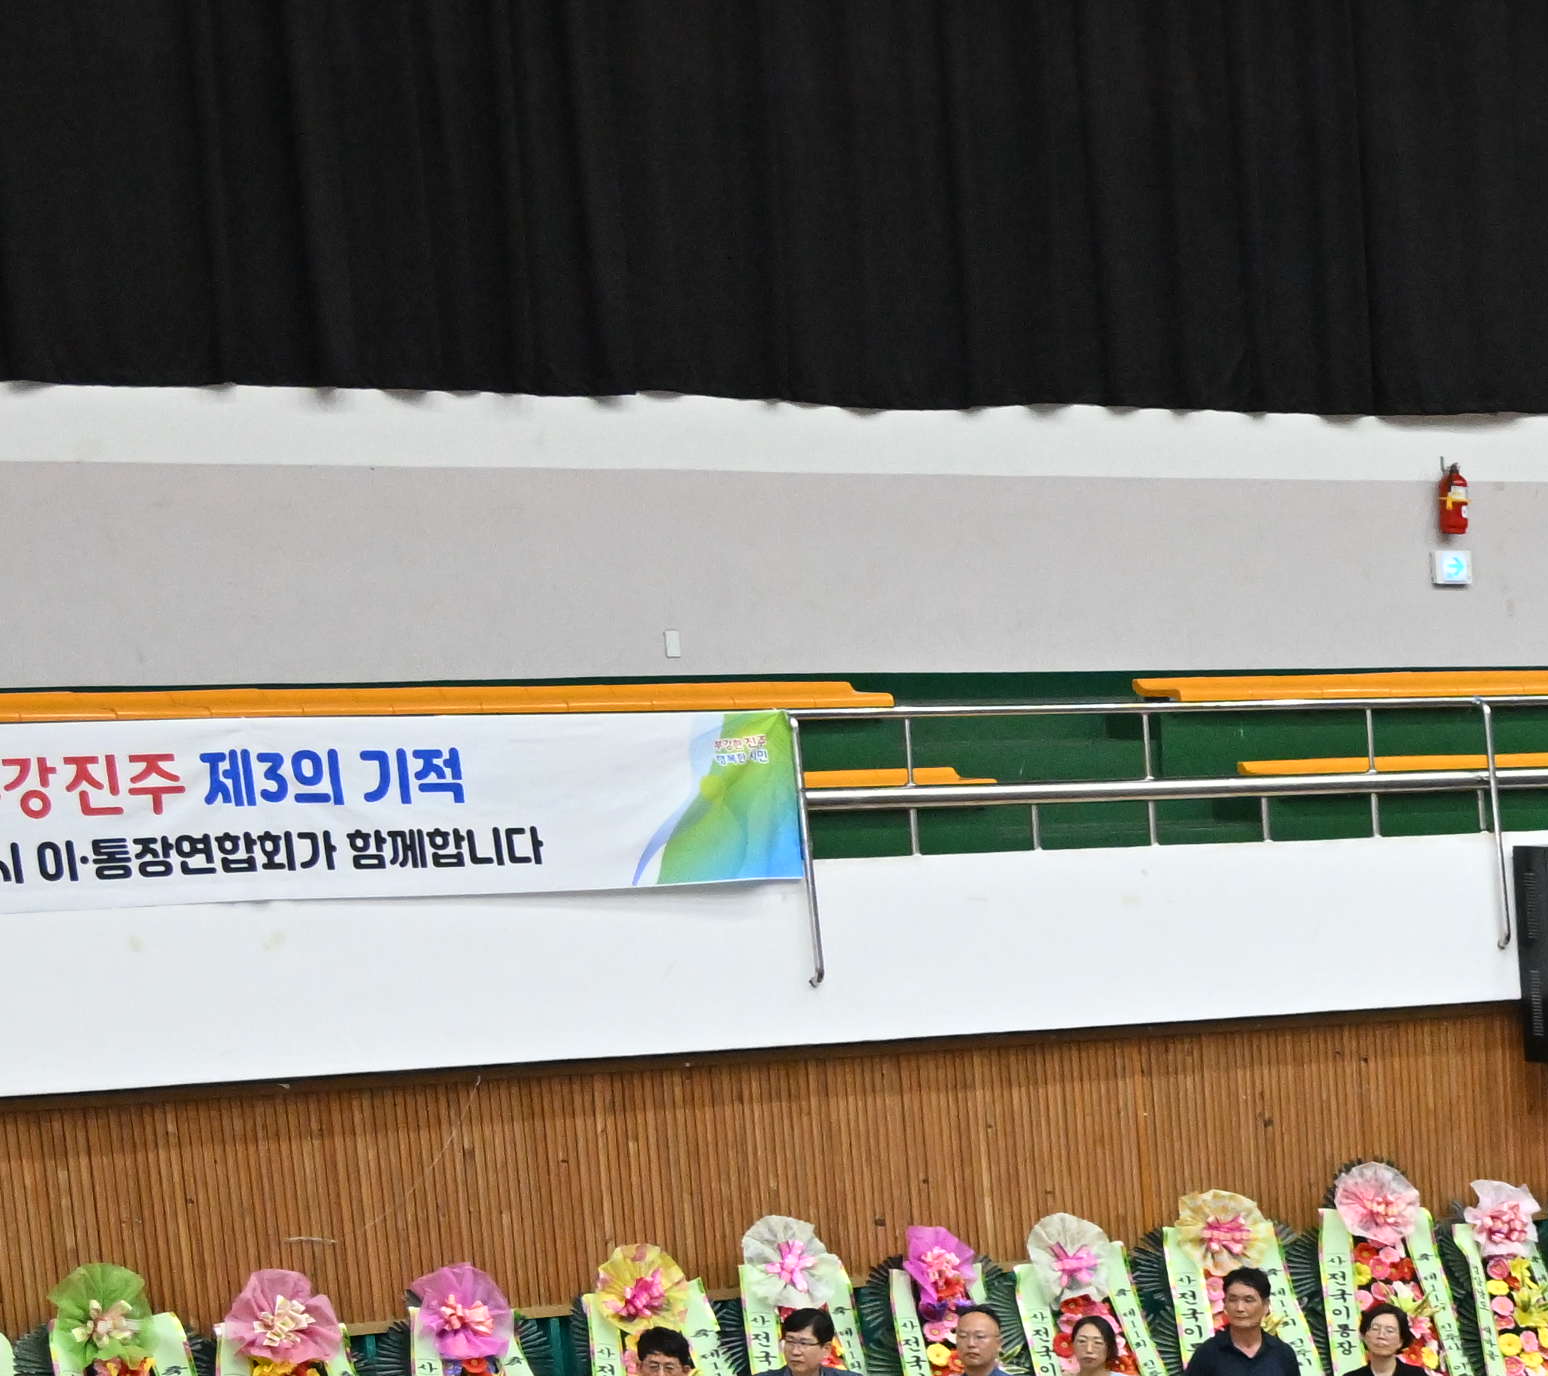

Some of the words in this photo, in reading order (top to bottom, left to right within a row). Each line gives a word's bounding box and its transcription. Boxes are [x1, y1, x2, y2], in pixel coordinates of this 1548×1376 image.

[0, 753, 186, 819] 강진주
[200, 748, 345, 807] 제3의
[358, 746, 466, 806] 기적
[349, 825, 544, 871] 함께합니다
